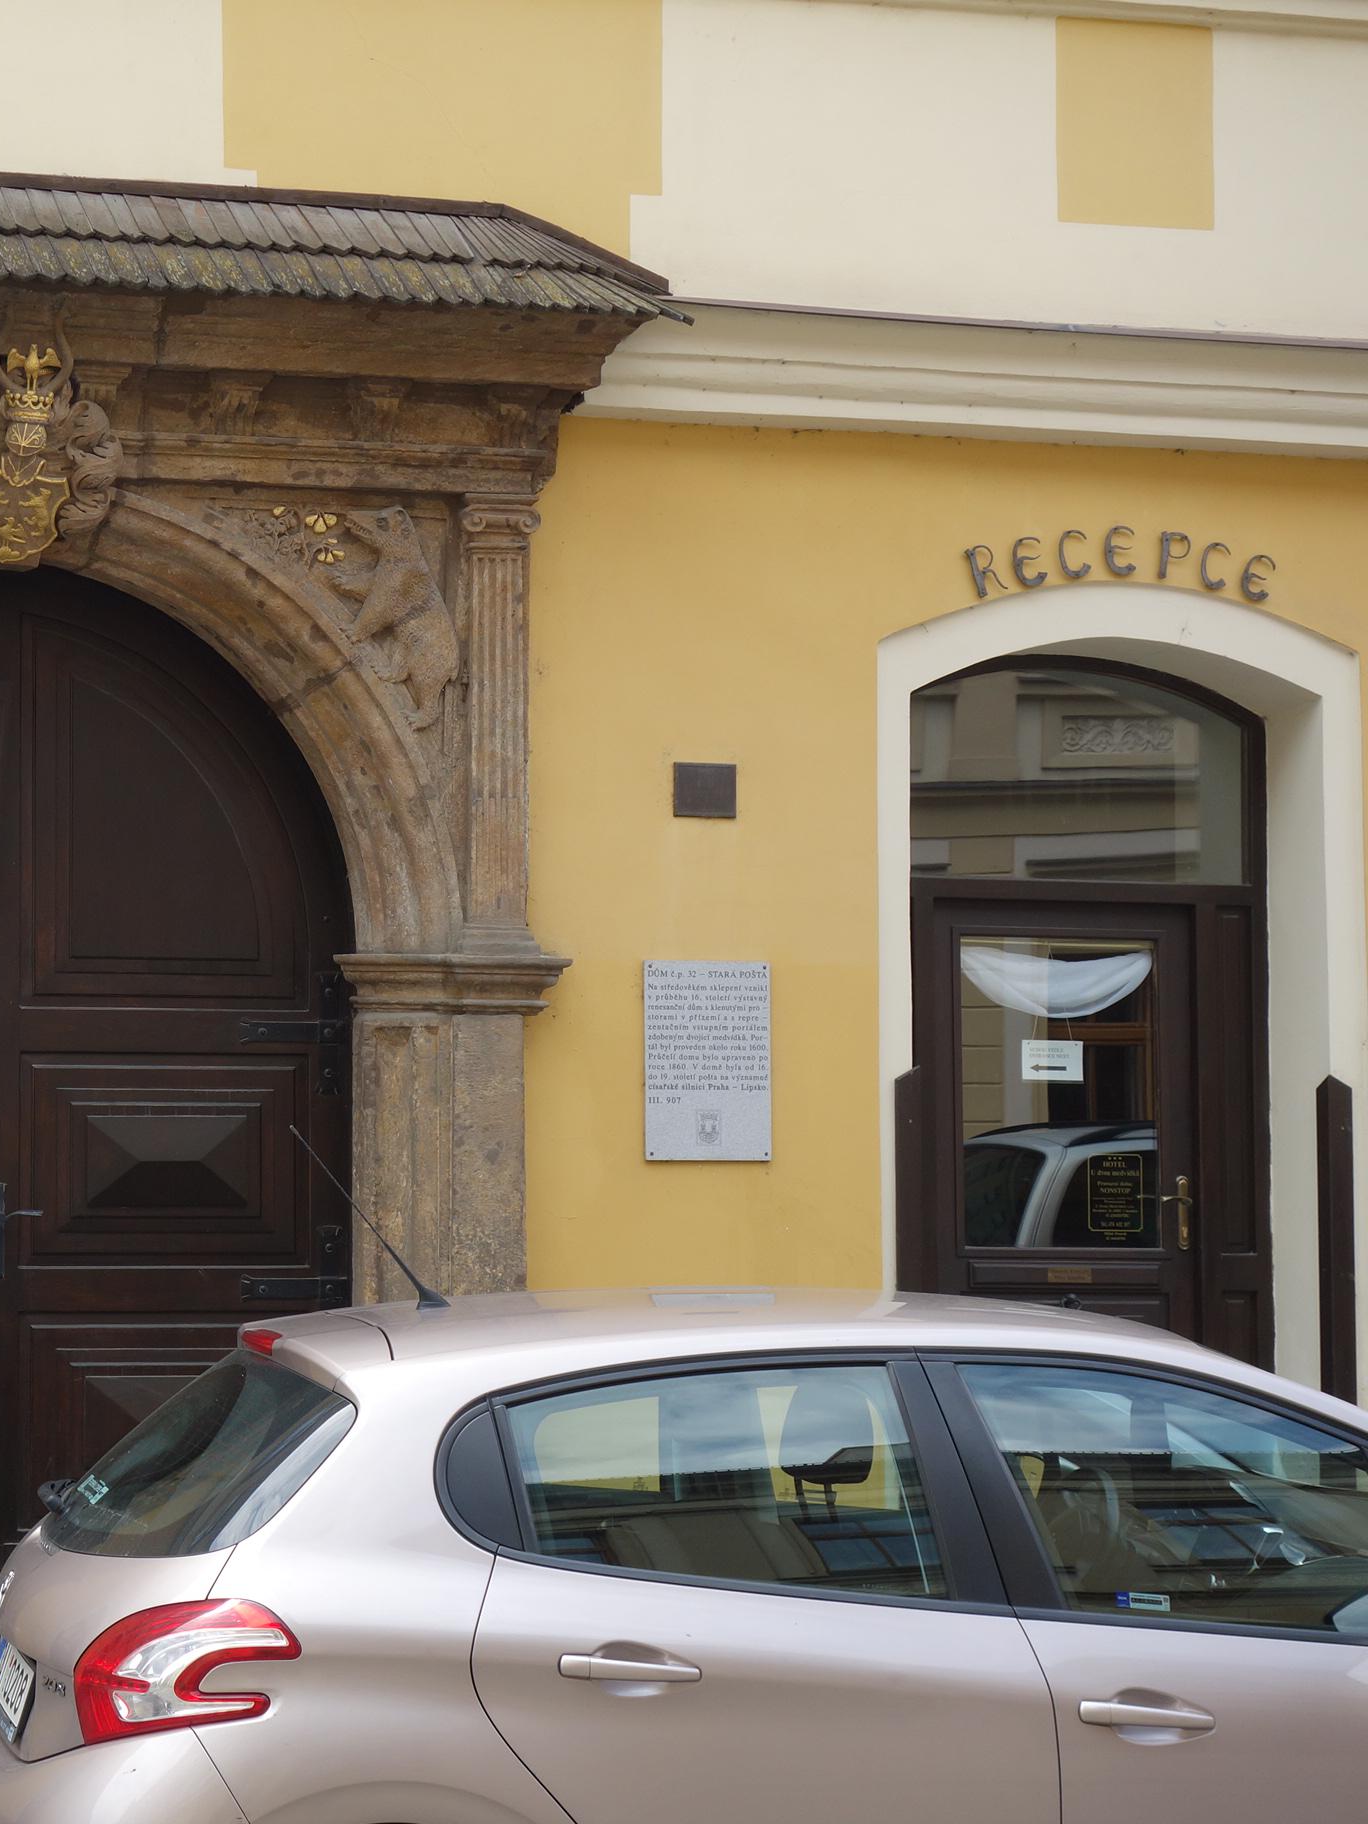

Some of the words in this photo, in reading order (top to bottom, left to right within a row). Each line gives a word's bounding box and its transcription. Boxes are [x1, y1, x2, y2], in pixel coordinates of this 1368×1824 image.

[964, 525, 1277, 601] RECEPCE
[688, 970, 696, 978] 32
[739, 970, 768, 979] POŠTA
[656, 994, 688, 1002] průběhu
[687, 1002, 703, 1011] dům
[678, 1053, 700, 1061] domu
[702, 1054, 719, 1062] bylo
[666, 1096, 682, 1104] 907
